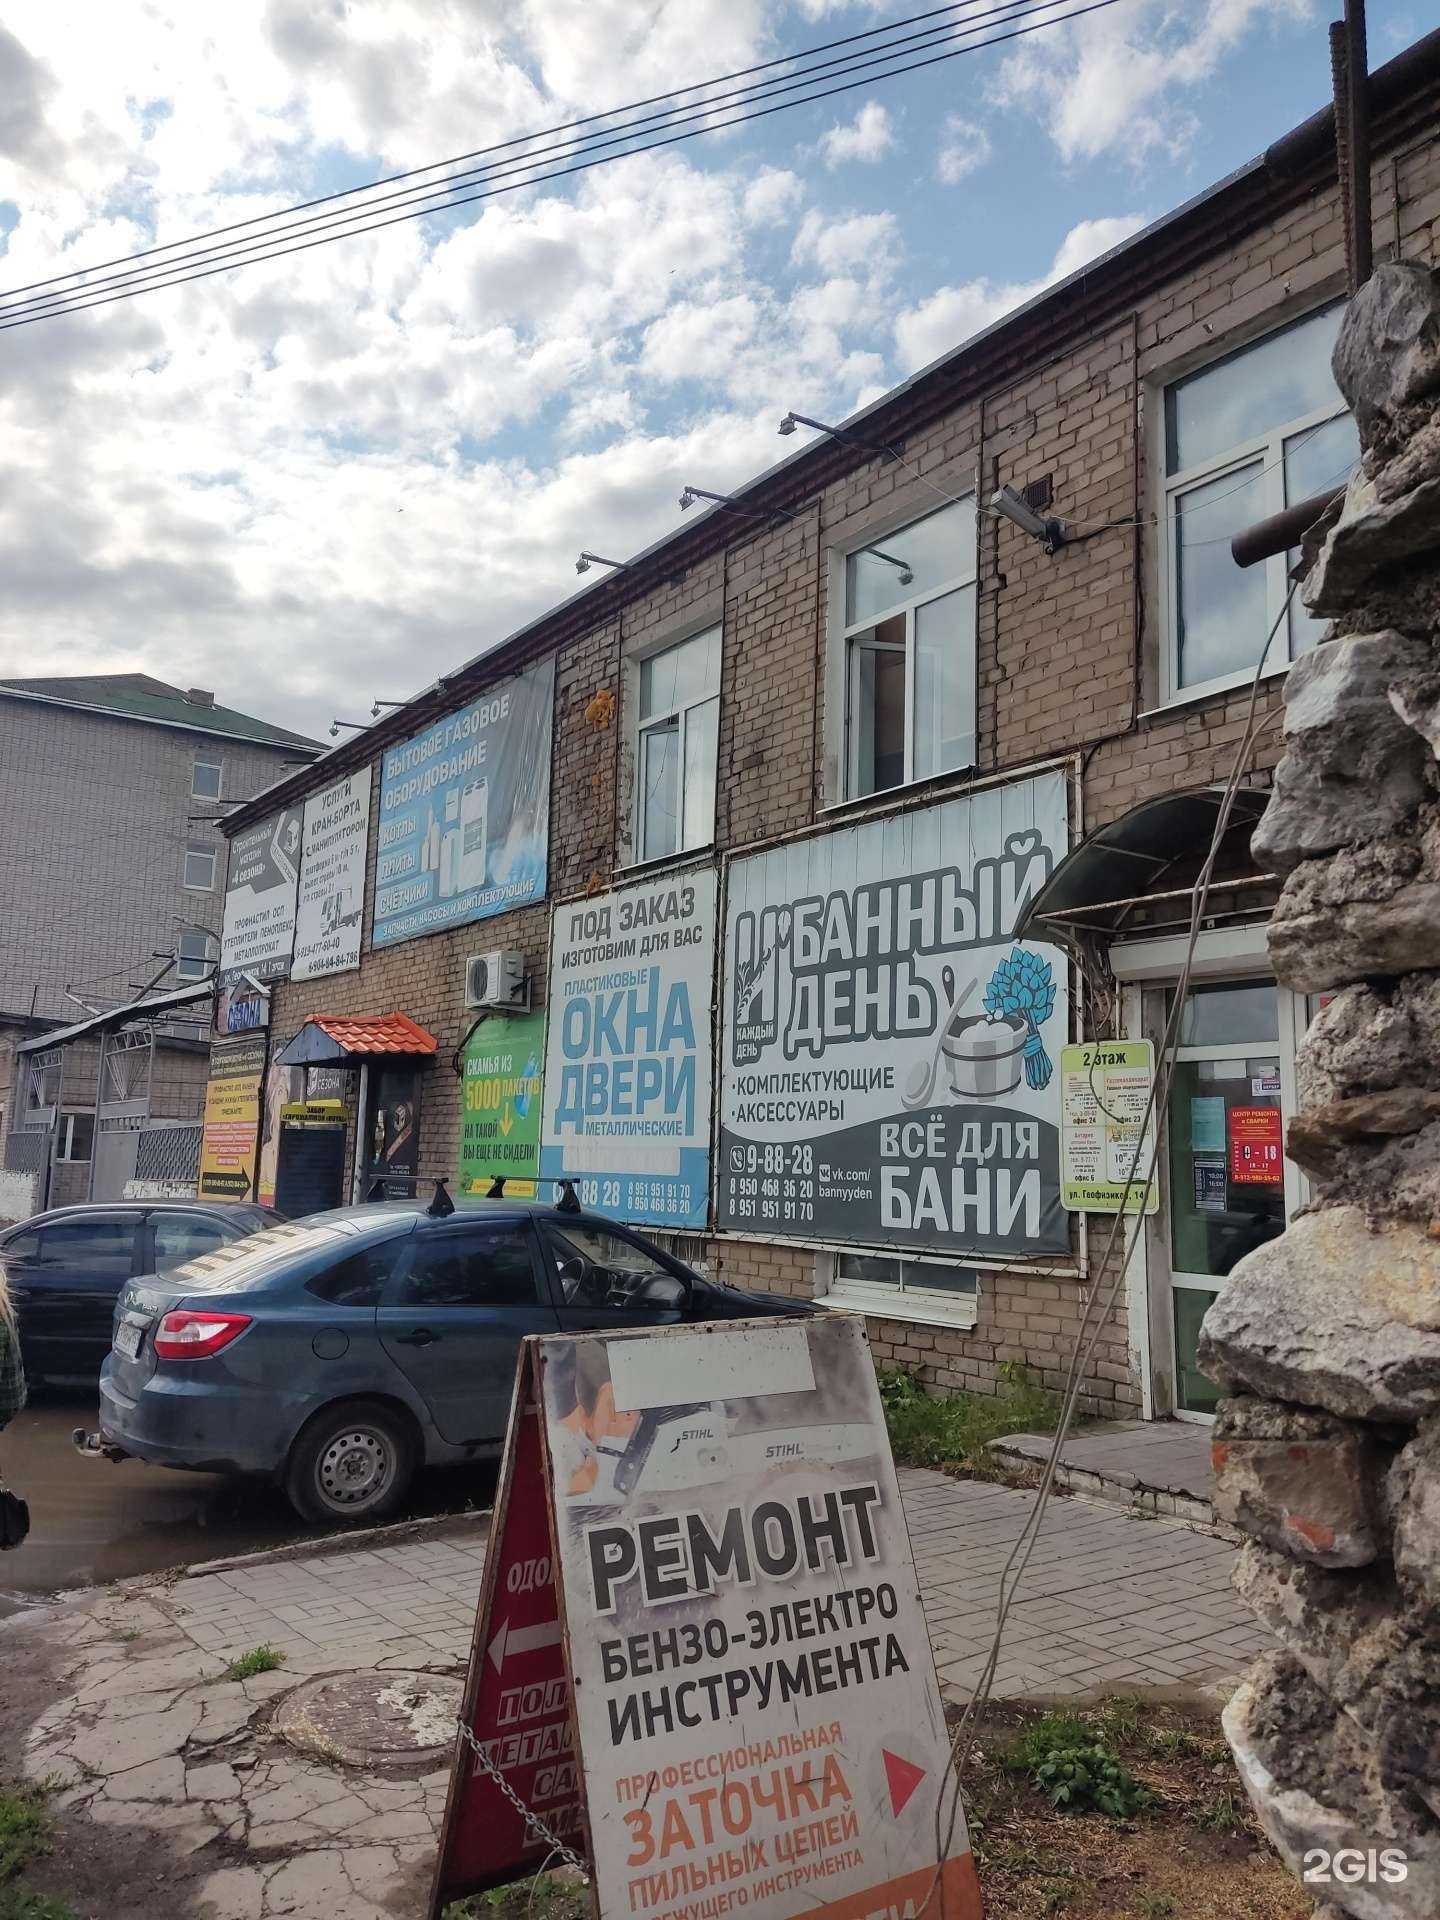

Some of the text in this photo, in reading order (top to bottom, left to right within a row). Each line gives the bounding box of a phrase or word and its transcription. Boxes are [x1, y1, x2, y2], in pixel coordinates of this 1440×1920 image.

[387, 694, 510, 780] БЫТОВОЕ ГАЗОВОЕ
[385, 740, 488, 811] ОБОРУДОВАНИЕ
[322, 781, 351, 810] УСЛУГИ
[311, 799, 360, 837] КРАН-БОРТА
[383, 815, 416, 846] КОТЛЫ
[381, 852, 415, 880] ПЛИТЫ
[380, 879, 428, 913] СЧЁТЧИКИ
[456, 878, 535, 913] КОМПЛЕКТУЮЩИЕ
[792, 836, 1050, 969] БАННЫЙ
[234, 909, 270, 930] ПРОФНАСТИЛ
[570, 887, 695, 942] ПОД ЗАКАЗ
[562, 925, 703, 969] ИЗГОТОВИМ ДЛЯ ВАС
[564, 969, 648, 997] ПЛАСТИКОВЫЕ
[561, 966, 697, 1060] ОКНА
[787, 960, 934, 1054] ДЕНЬ
[735, 1021, 774, 1042] КАЖДЫЙ
[467, 1054, 513, 1076] СКАМЬЯ ИЗ
[735, 1042, 758, 1061] ДЕНЬ
[1083, 1052, 1127, 1066] 2 этаж
[465, 1077, 541, 1111] 5000 ПАКЕТОВ
[737, 1066, 895, 1095] КОМПЛЕКТУЮЩИЕ
[554, 1055, 696, 1137] ДВЕРИ
[736, 1099, 844, 1123] АКСЕССУАРЫ
[1116, 1115, 1132, 1124] фис
[464, 1119, 498, 1139] НА ТАКОЙ
[585, 1119, 683, 1137] МЕТАЛЛИЧЕСКИЕ
[879, 1114, 1039, 1165] ВСЁ ДЛЯ
[463, 1143, 535, 1164] ВЫ ЕЩЕ НЕ СИДЕЛИ
[747, 1144, 813, 1175] 9-88-28
[1264, 1145, 1277, 1160] 18
[729, 1178, 813, 1198] 8 950 468 36 20
[832, 1168, 871, 1182] vk.com/
[581, 1180, 599, 1206] 88
[602, 1180, 621, 1207] 28
[627, 1182, 690, 1199] 8 951 951 91 70
[627, 1196, 690, 1214] 8 950 468 36 20
[818, 1185, 873, 1202] bannyyden
[880, 1164, 1041, 1239] БАНИ
[1069, 1191, 1080, 1200] ул.
[1082, 1189, 1132, 1201] Геофизико,
[729, 1198, 814, 1221] 8 951 951 91 70
[682, 1428, 714, 1441] STIHL
[766, 1443, 804, 1458] STIHL
[585, 1483, 881, 1612] РЕМОНТ
[507, 1557, 555, 1595] ОДО
[600, 1582, 899, 1684] БЕНЗО-ЭЛЕКТРО
[607, 1633, 910, 1746] ИНСТРУМЕНТА
[615, 1721, 843, 1803] ПРОФЕССИОНАЛЬНАЯ
[622, 1753, 853, 1867] ЗАТОЧКА
[628, 1803, 860, 1912] ПИЛЬНЫХ ЦЕПЕЙ
[652, 1848, 865, 1920] ЖУЩЕГО ИНСТРУМЕНТА
